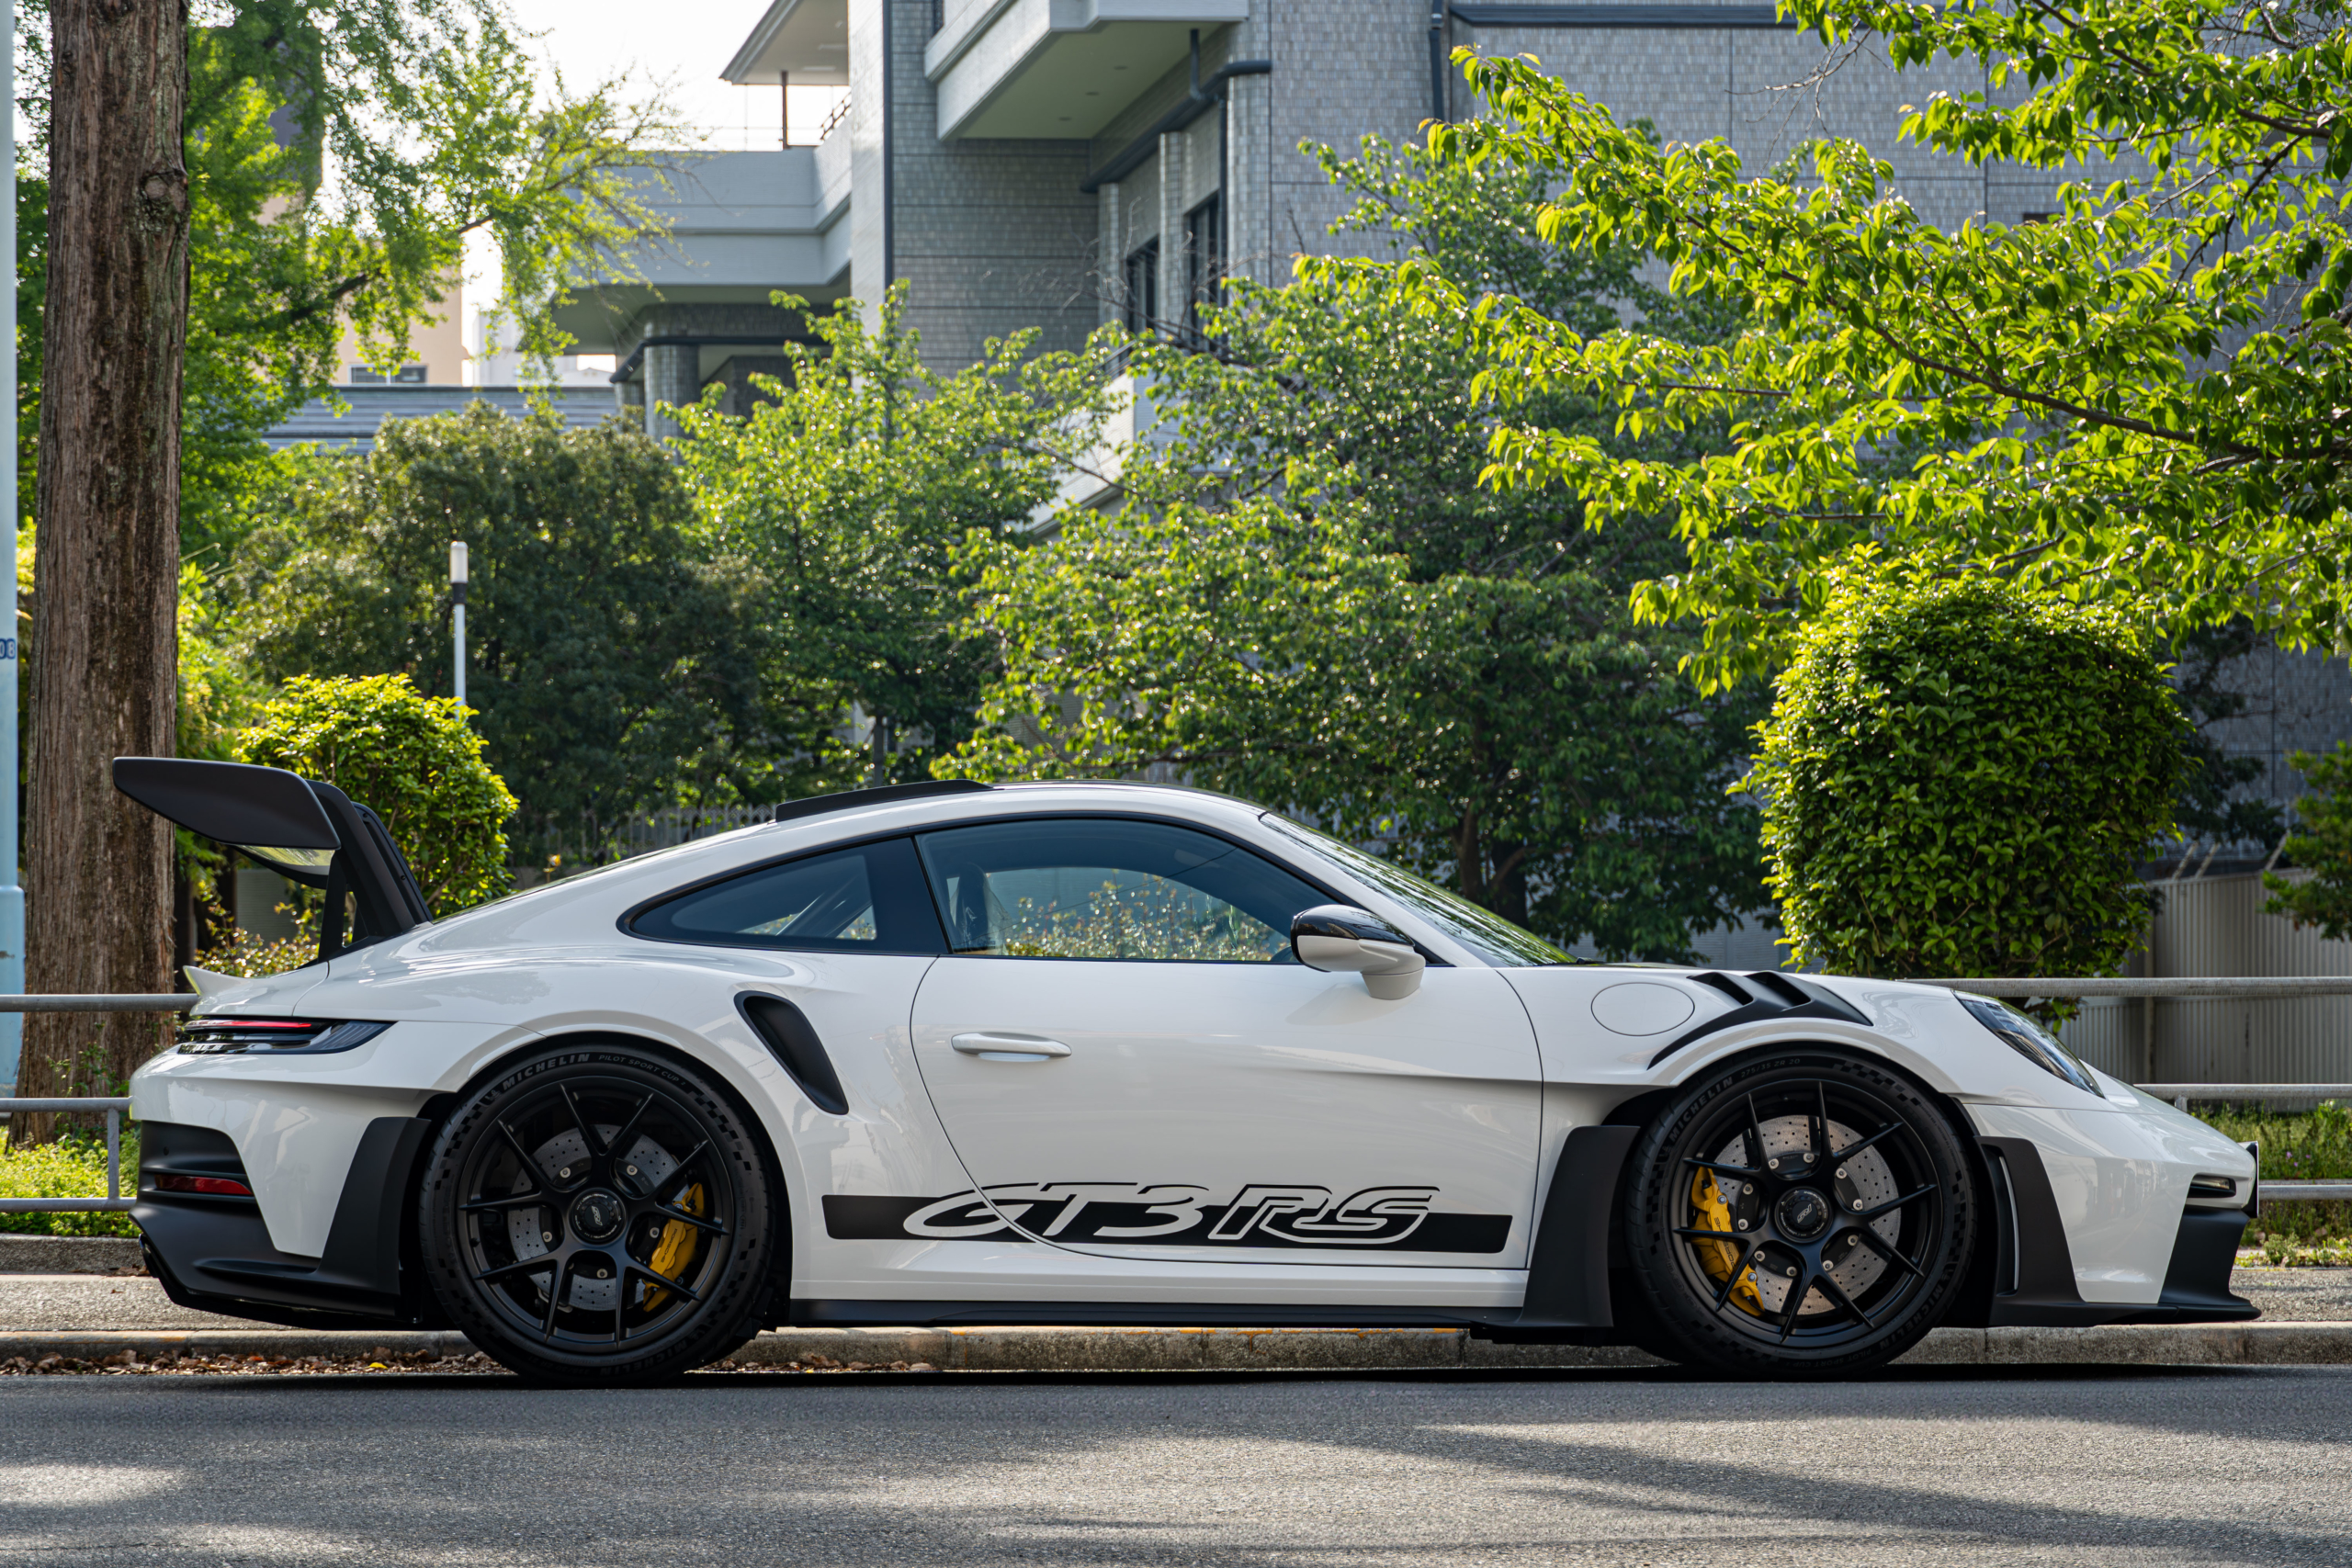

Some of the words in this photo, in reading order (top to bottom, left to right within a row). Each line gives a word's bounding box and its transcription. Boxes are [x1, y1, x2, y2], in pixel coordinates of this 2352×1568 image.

[503, 1054, 591, 1091] MICHELIN
[598, 1055, 627, 1063] PILOT
[628, 1058, 660, 1073] SPORT
[661, 1070, 680, 1083] CUP
[1668, 1077, 1734, 1144] MICHELIN
[1741, 1062, 1771, 1078] 275/35
[903, 1182, 1209, 1237] GT3
[1207, 1184, 1441, 1245] RS
[661, 1228, 678, 1263] PORSCHE
[1714, 1216, 1736, 1269] PORSHE
[1879, 1283, 1944, 1350] MICHELIN
[599, 1342, 688, 1376] MICHELIN
[1793, 1359, 1812, 1368] CUP
[1815, 1358, 1844, 1368] SPORT
[1847, 1348, 1872, 1362] PILOT
